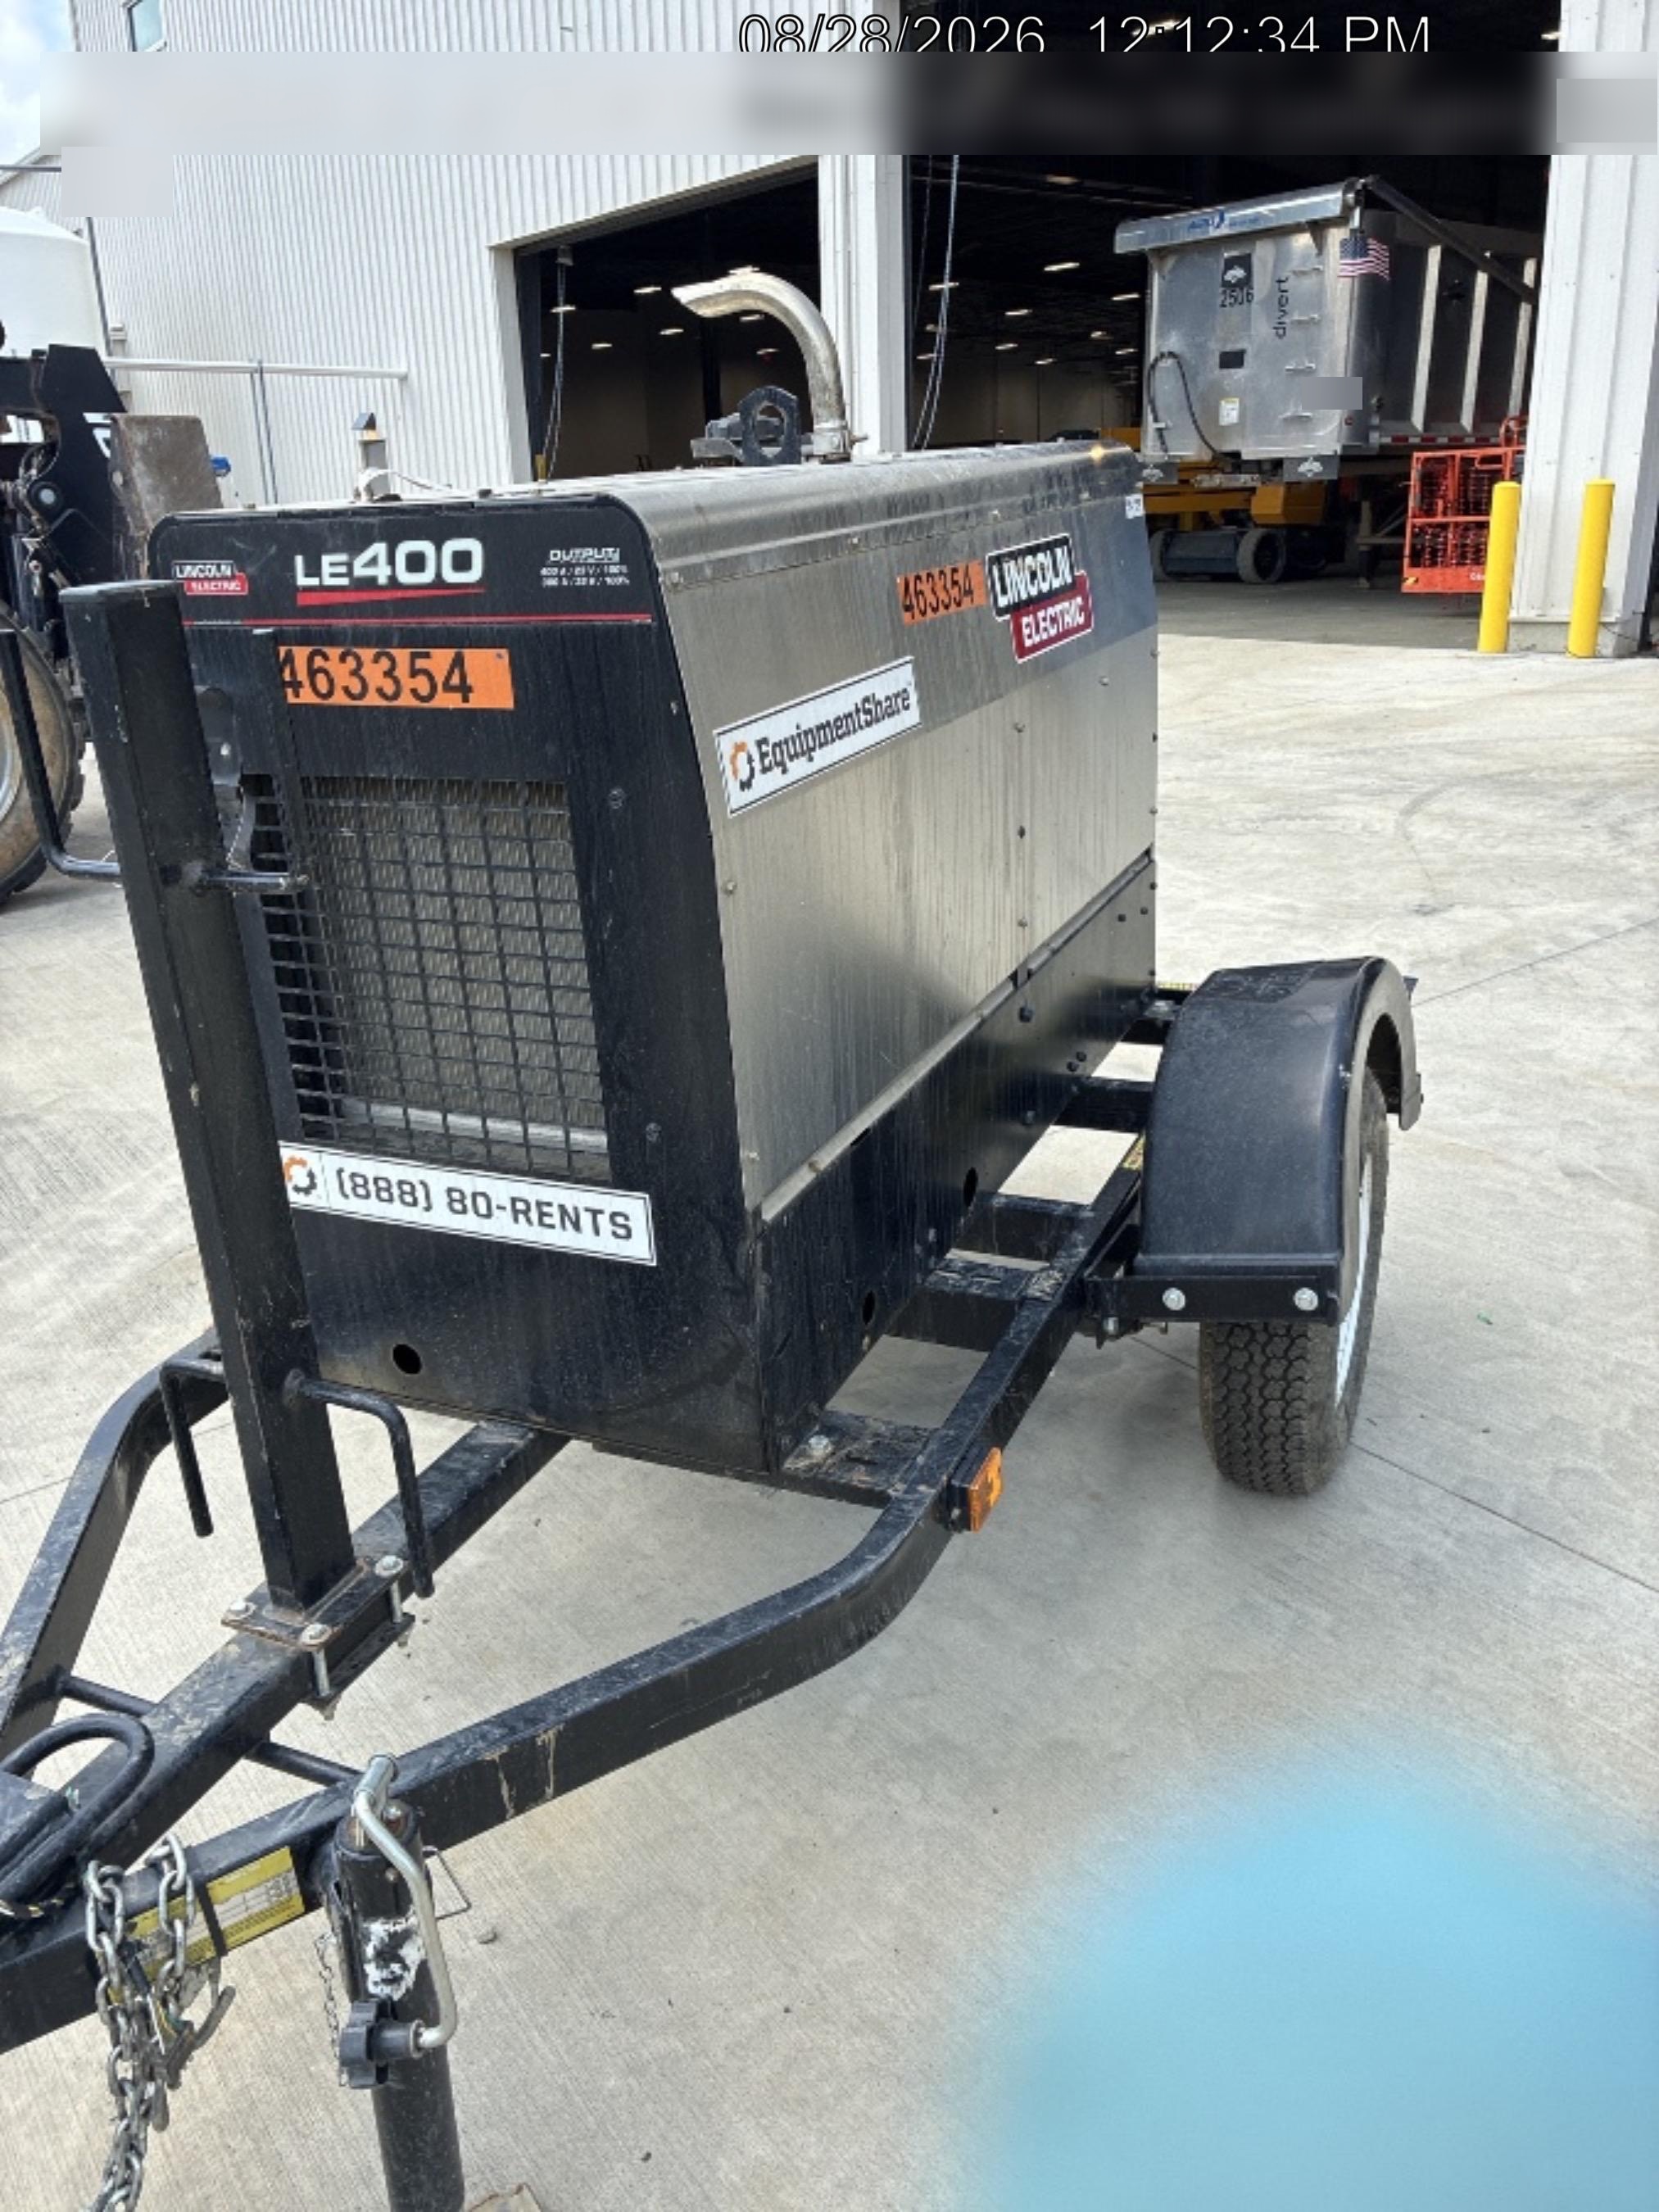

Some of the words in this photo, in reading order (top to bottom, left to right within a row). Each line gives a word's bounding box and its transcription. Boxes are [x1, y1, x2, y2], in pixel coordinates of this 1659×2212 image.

[1272, 276, 1289, 339] divert
[294, 537, 482, 586] LE400
[992, 544, 1072, 607] LINCOLN
[902, 567, 974, 619] 463354
[1021, 595, 1086, 648] ELECTRIC
[281, 646, 473, 704] 463354
[757, 685, 910, 775] EquipmentShare
[335, 1167, 432, 1212] (888)
[446, 1186, 633, 1240] 80-RENTS
